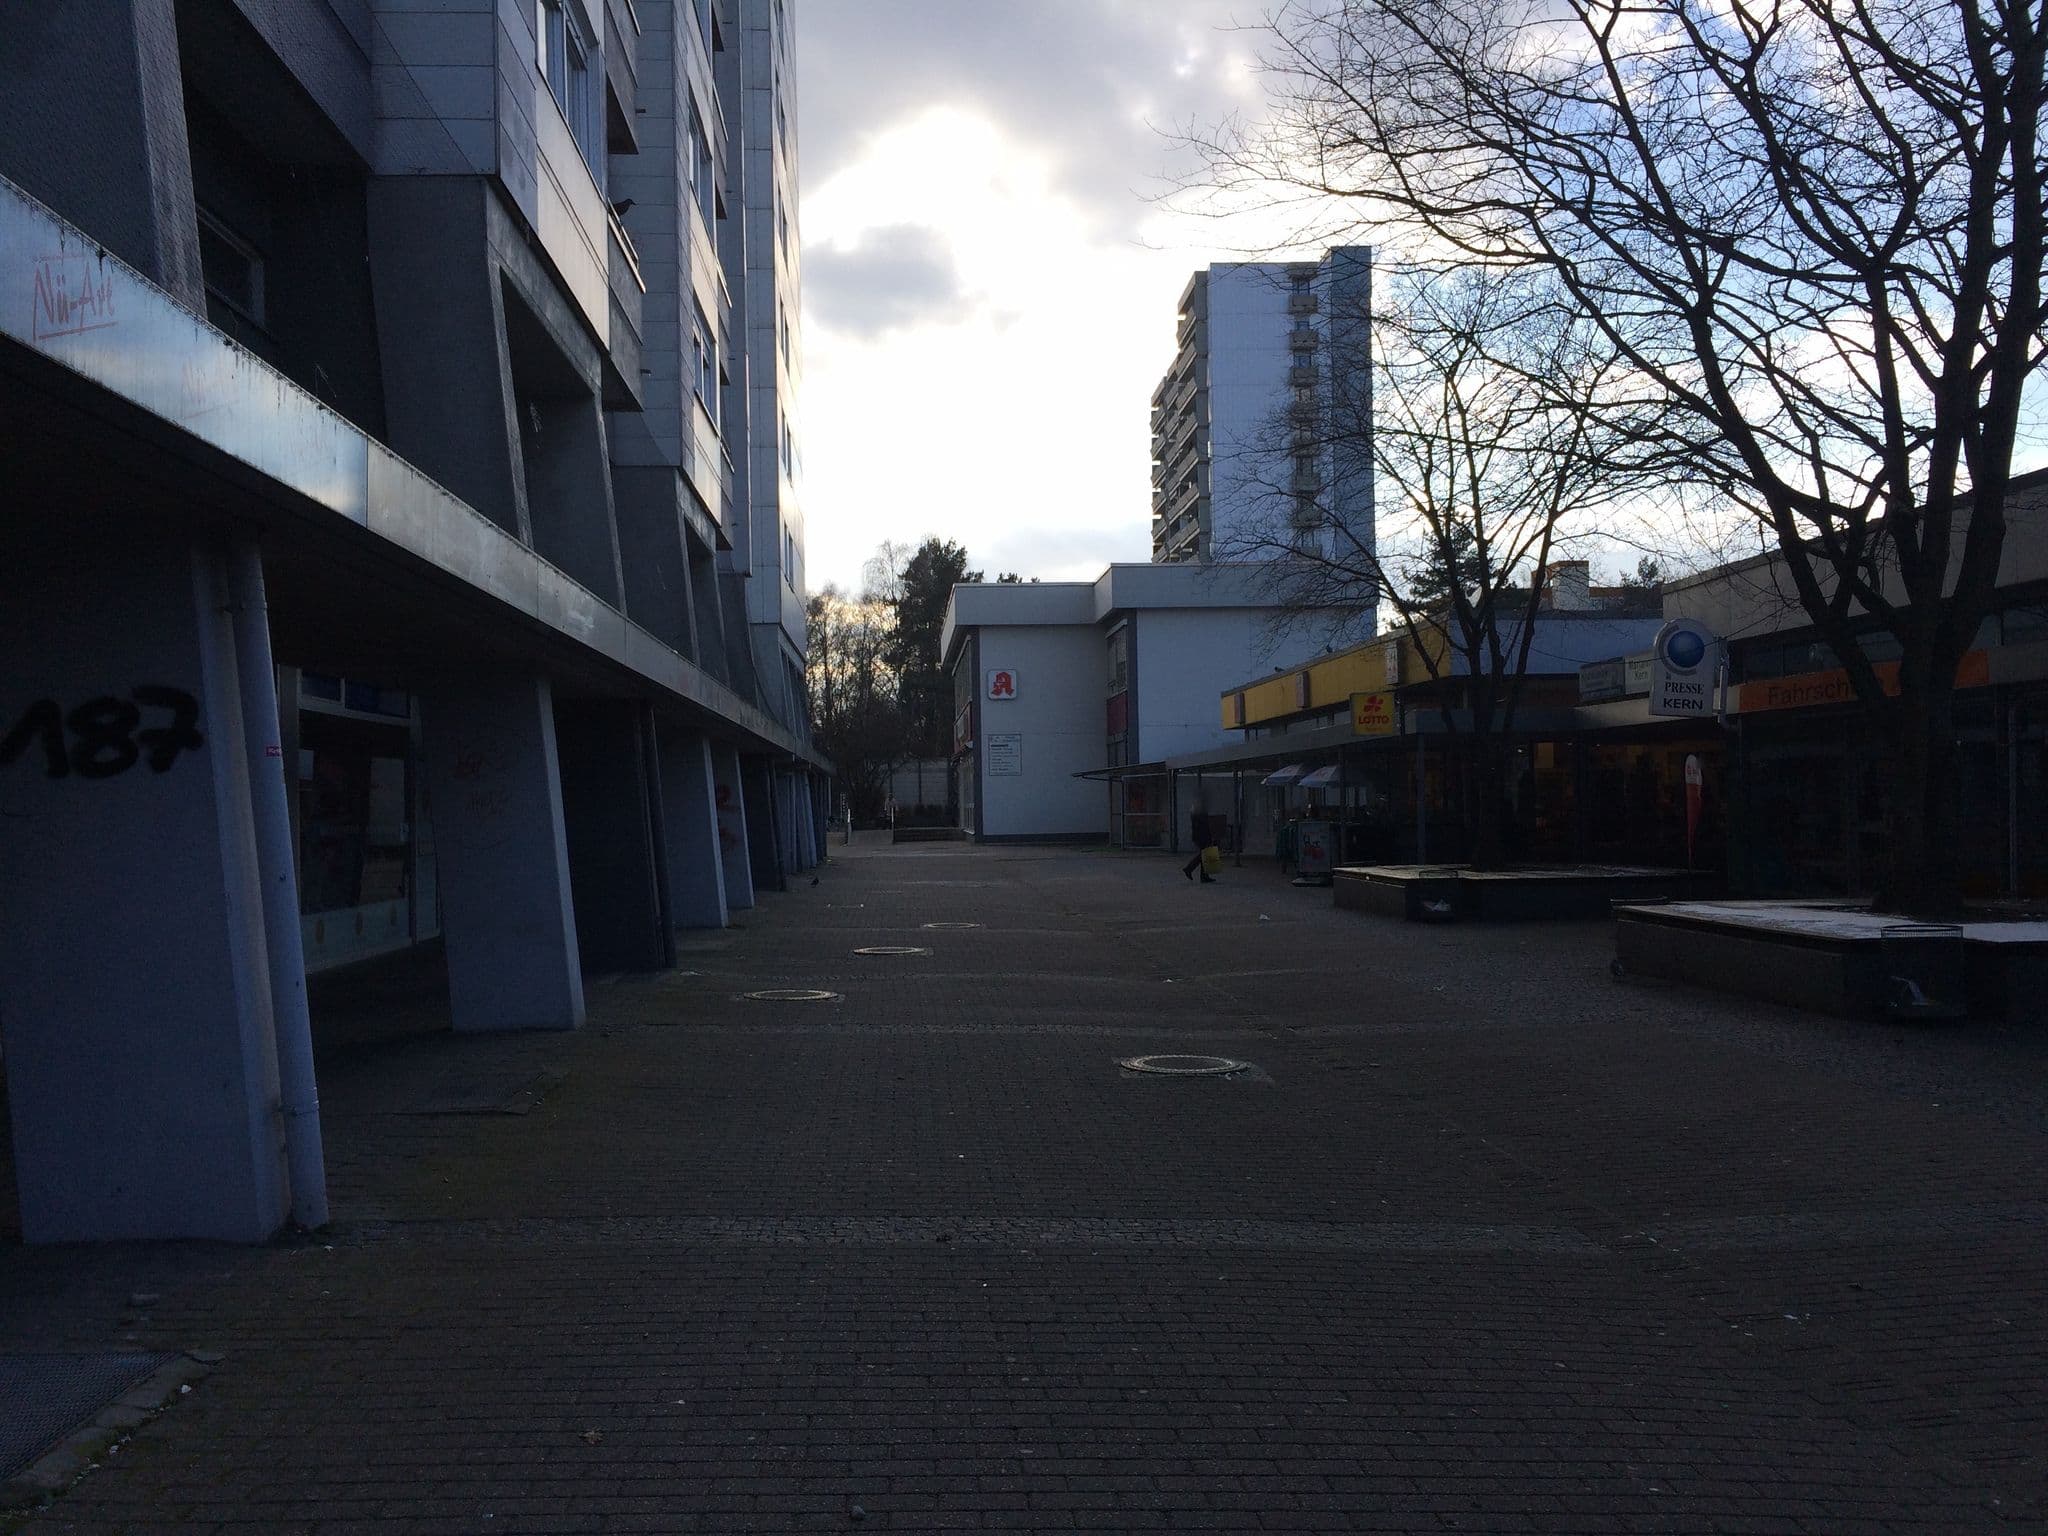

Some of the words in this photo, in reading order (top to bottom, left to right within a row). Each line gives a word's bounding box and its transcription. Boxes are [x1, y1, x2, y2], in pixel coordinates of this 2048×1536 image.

[1664, 681, 1705, 695] PRESSE
[1768, 679, 1852, 705] Fahrsch
[1663, 697, 1704, 710] KERN
[1358, 714, 1390, 724] LOTTO
[0, 685, 204, 778] 187
